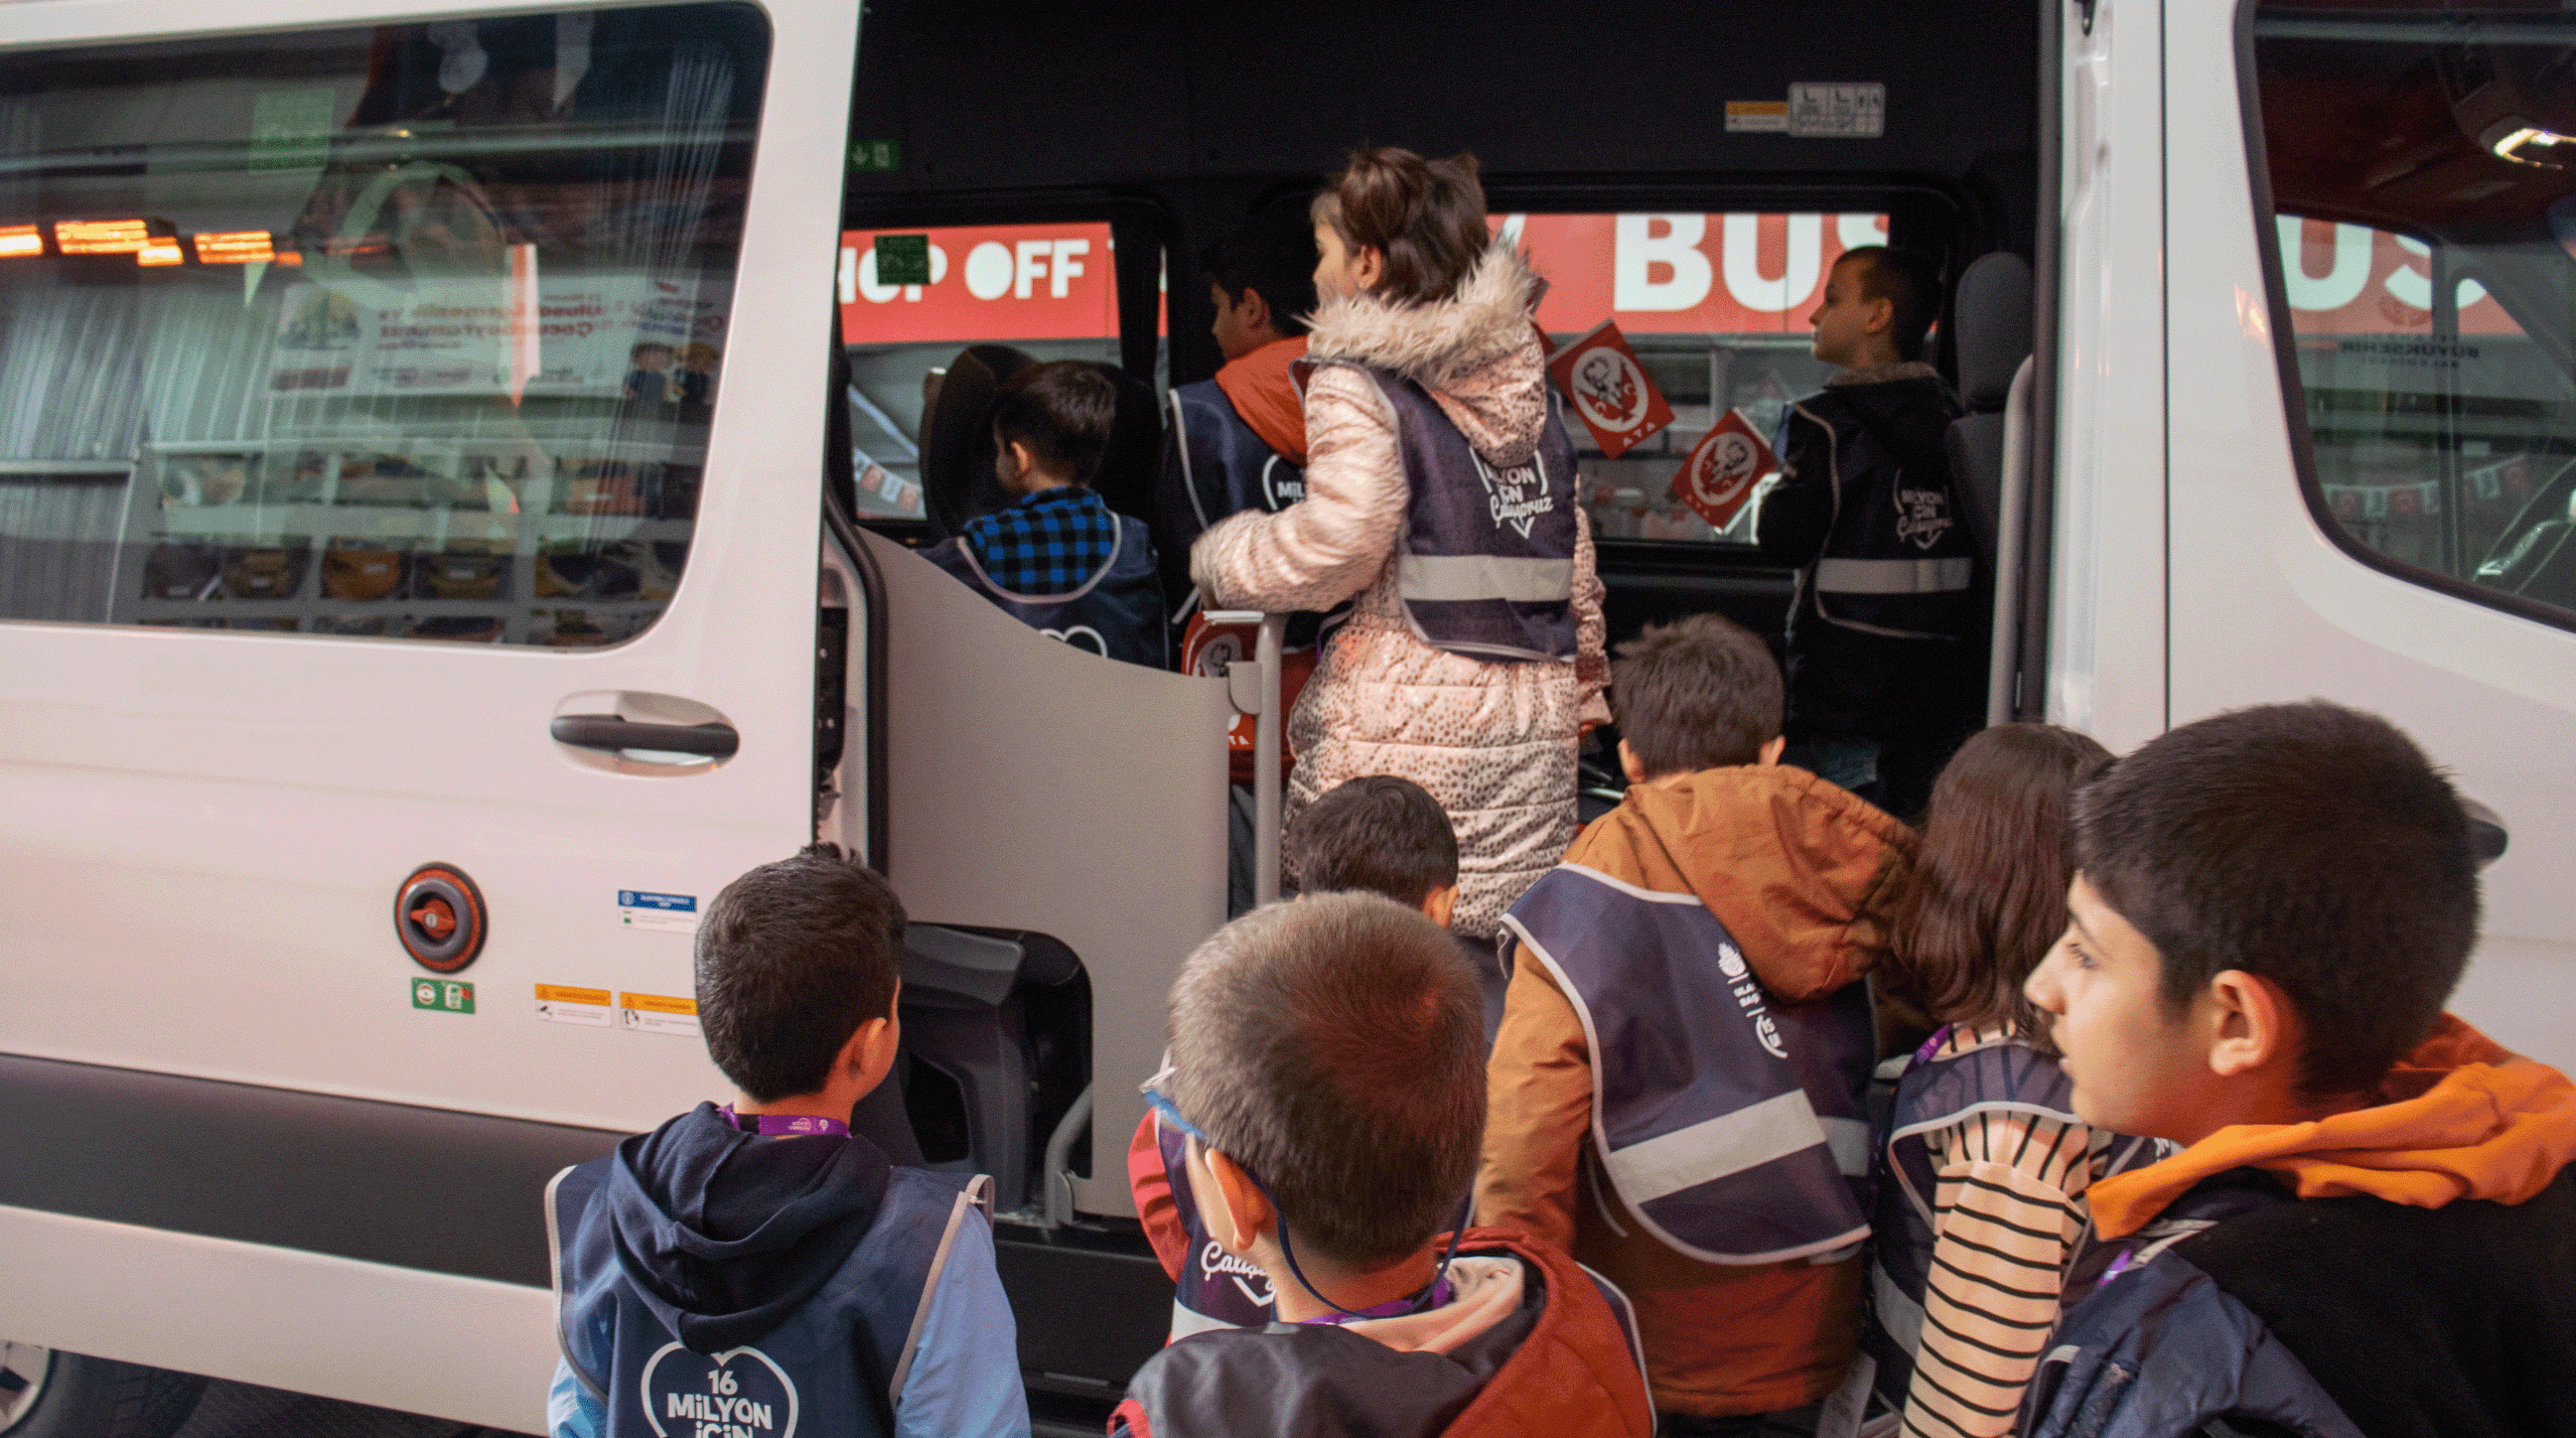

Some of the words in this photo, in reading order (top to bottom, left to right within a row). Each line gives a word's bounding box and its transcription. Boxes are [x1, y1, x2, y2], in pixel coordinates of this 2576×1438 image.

[964, 239, 1089, 300] OFF
[1615, 214, 1888, 312] BU
[708, 1369, 738, 1395] 16
